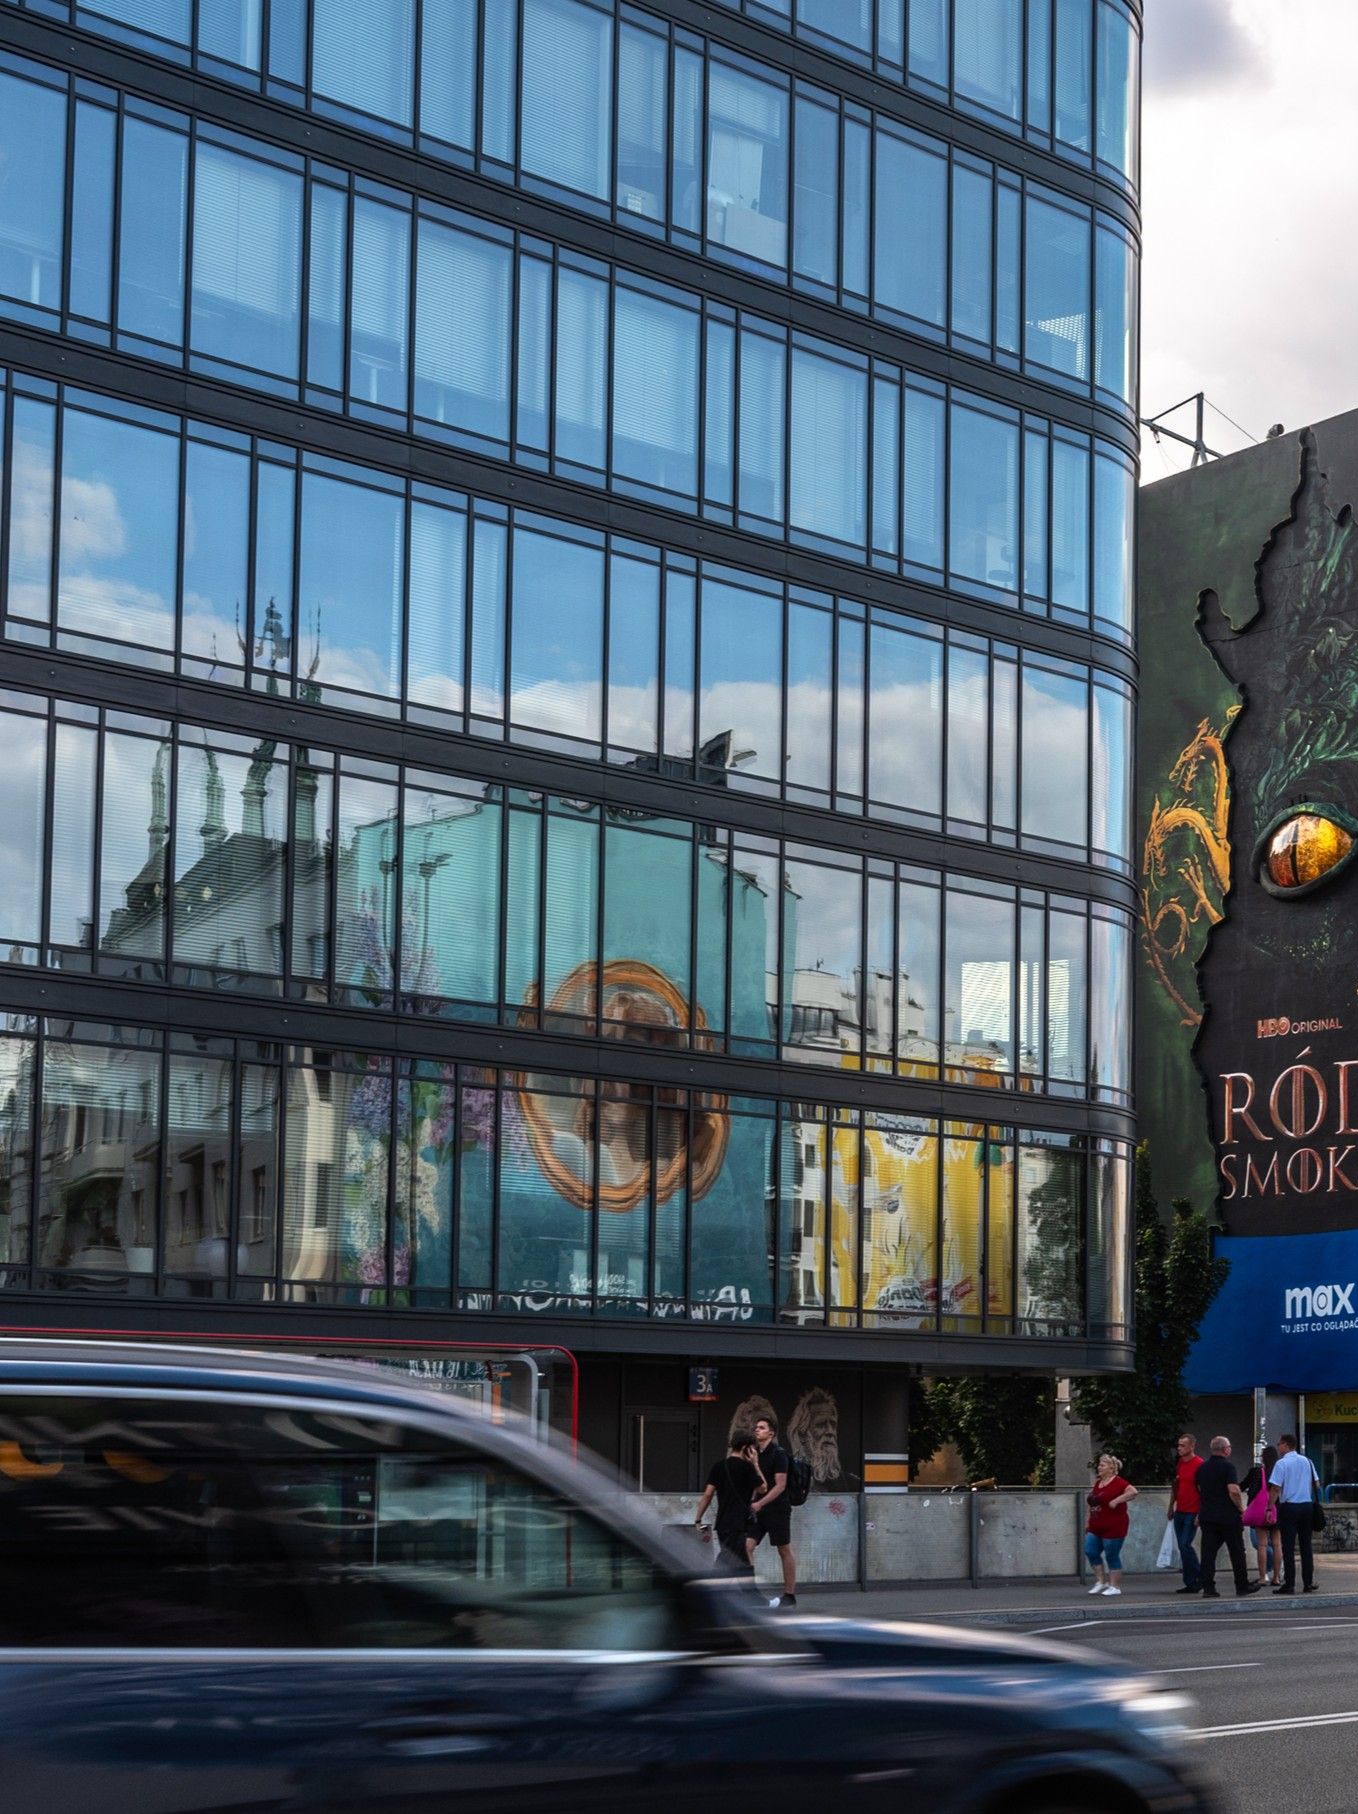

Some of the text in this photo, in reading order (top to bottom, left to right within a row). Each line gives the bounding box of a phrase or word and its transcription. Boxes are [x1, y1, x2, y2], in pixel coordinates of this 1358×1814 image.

[1256, 1016, 1343, 1039] HBO ORIGINAL
[1285, 1283, 1355, 1319] max
[1281, 1325, 1291, 1333] TU
[1292, 1323, 1309, 1333] JEST
[1311, 1322, 1322, 1332] CO
